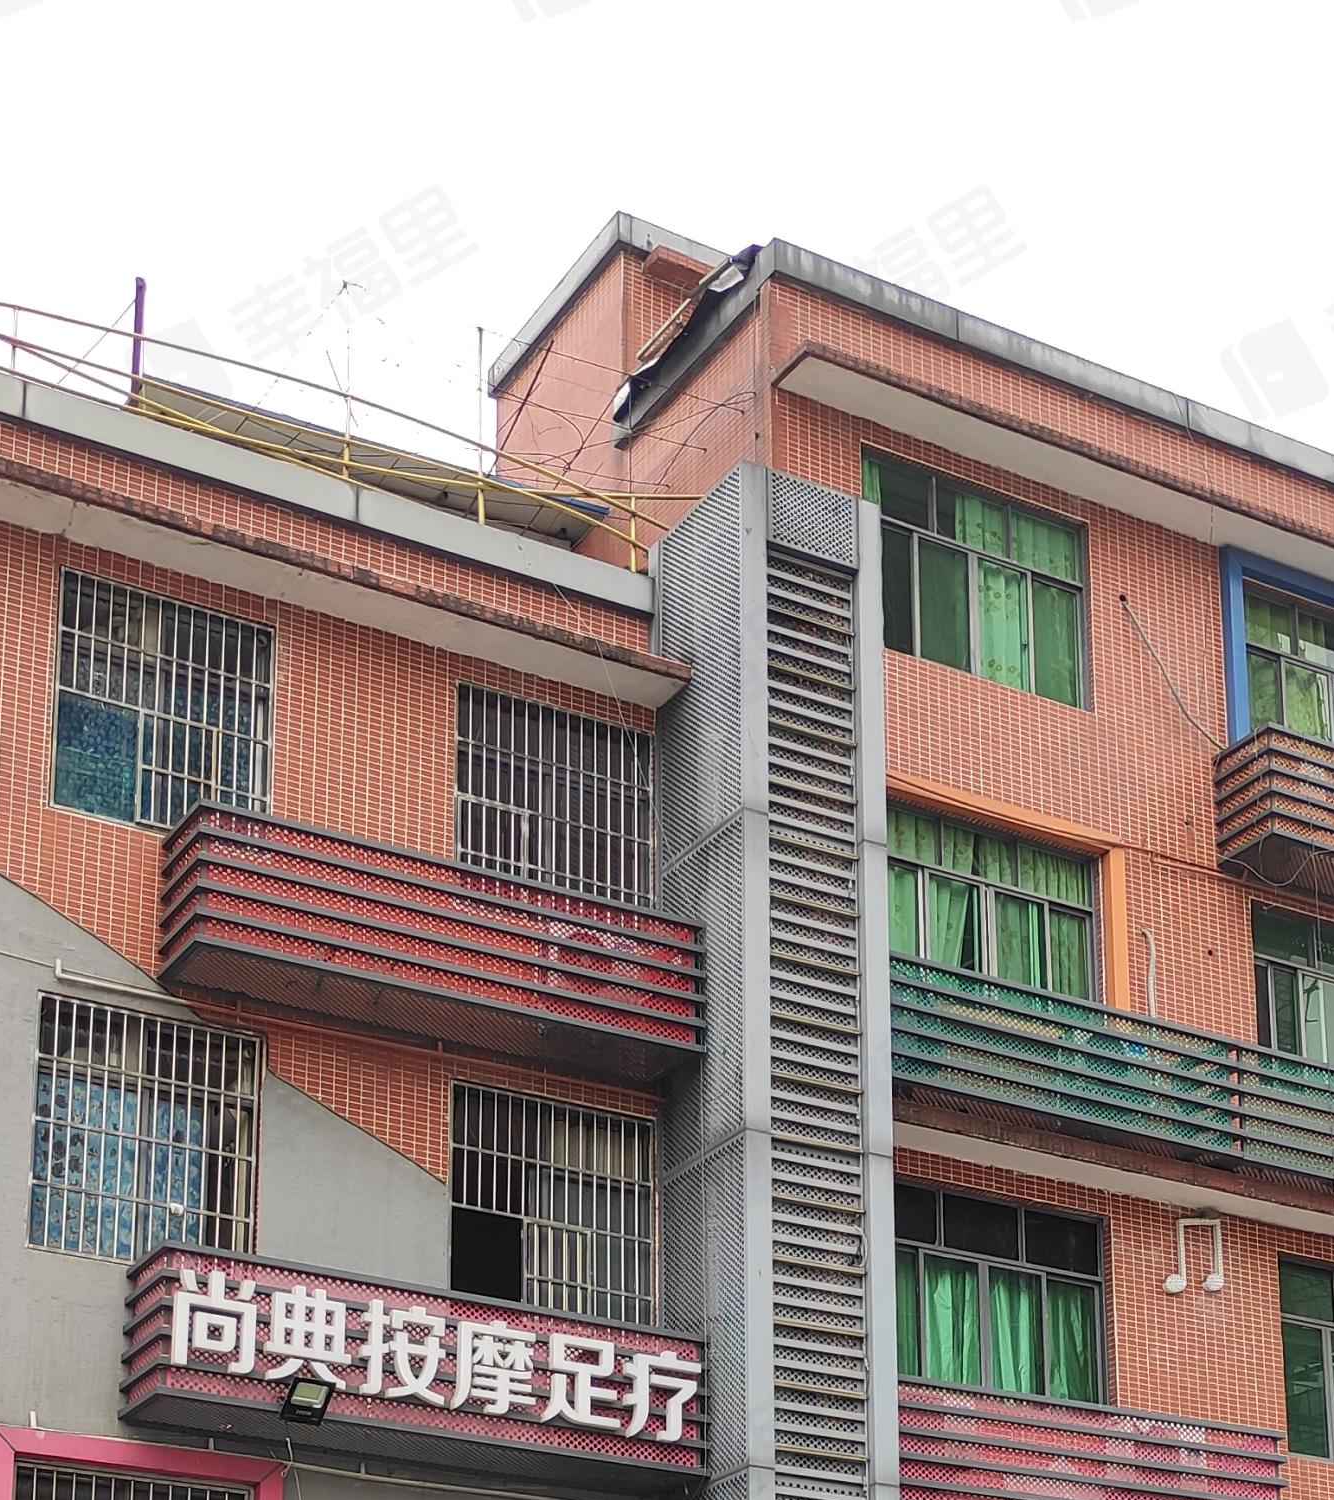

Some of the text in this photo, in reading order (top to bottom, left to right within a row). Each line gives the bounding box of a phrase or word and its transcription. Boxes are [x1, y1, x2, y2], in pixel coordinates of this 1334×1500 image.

[169, 1268, 703, 1442] 尚典按摩足疗
